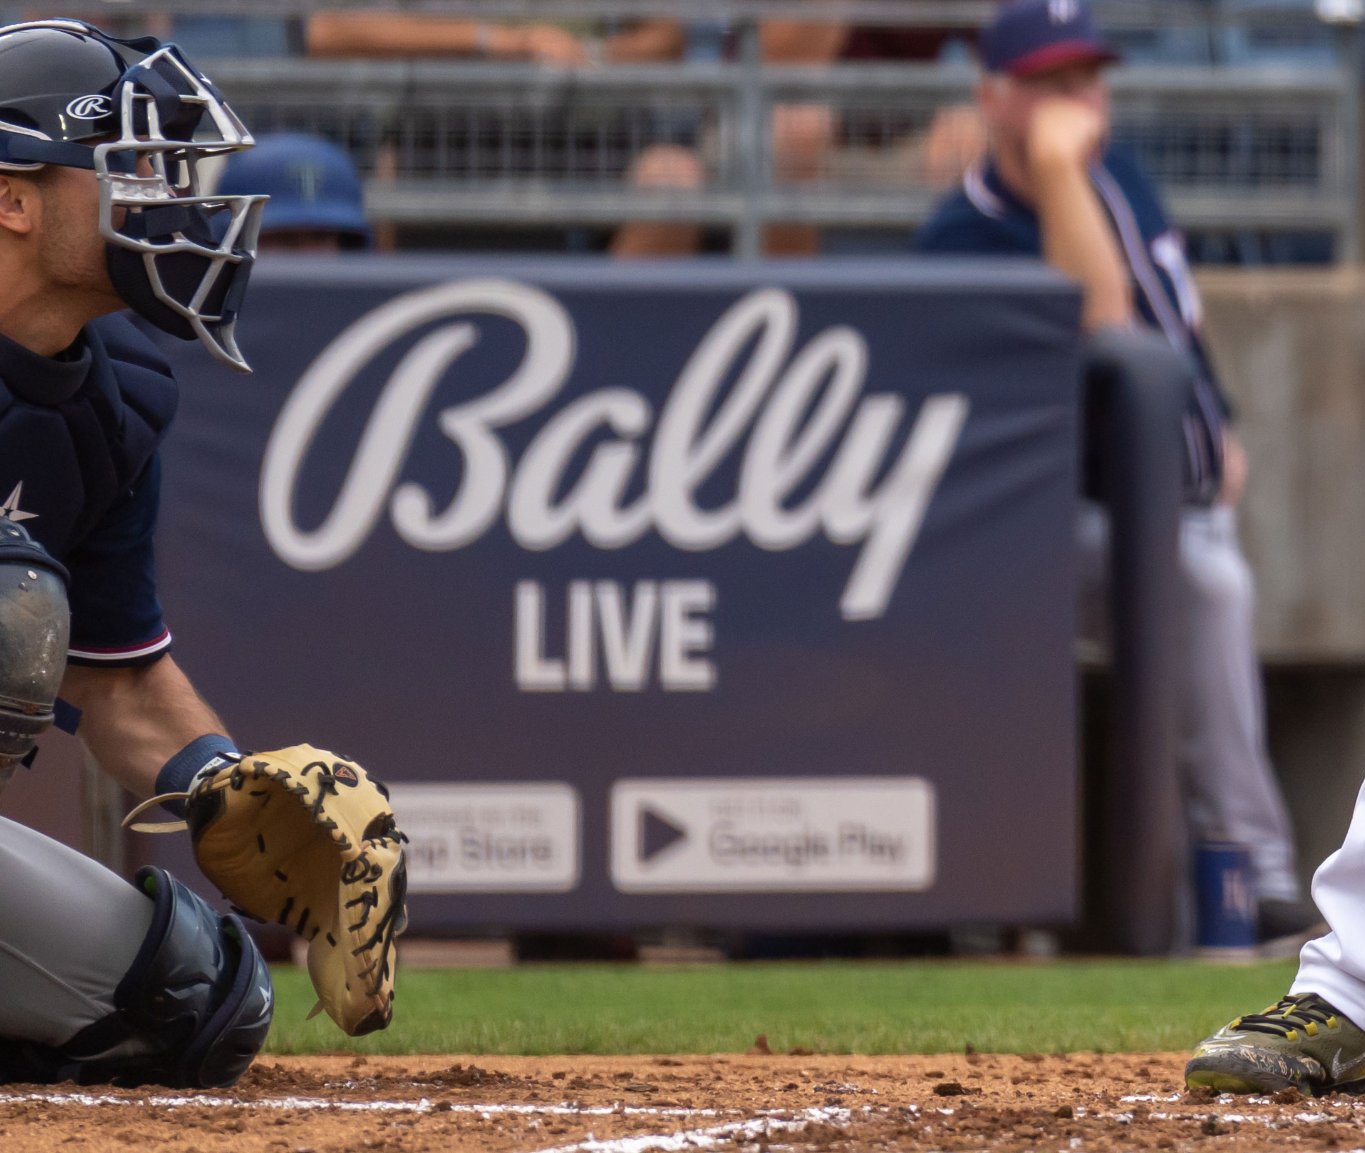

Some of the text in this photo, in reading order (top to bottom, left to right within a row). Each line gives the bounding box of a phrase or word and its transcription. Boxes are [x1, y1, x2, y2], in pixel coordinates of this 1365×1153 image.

[259, 278, 970, 622] Bally
[513, 580, 716, 691] LIVE
[708, 819, 829, 874] Google
